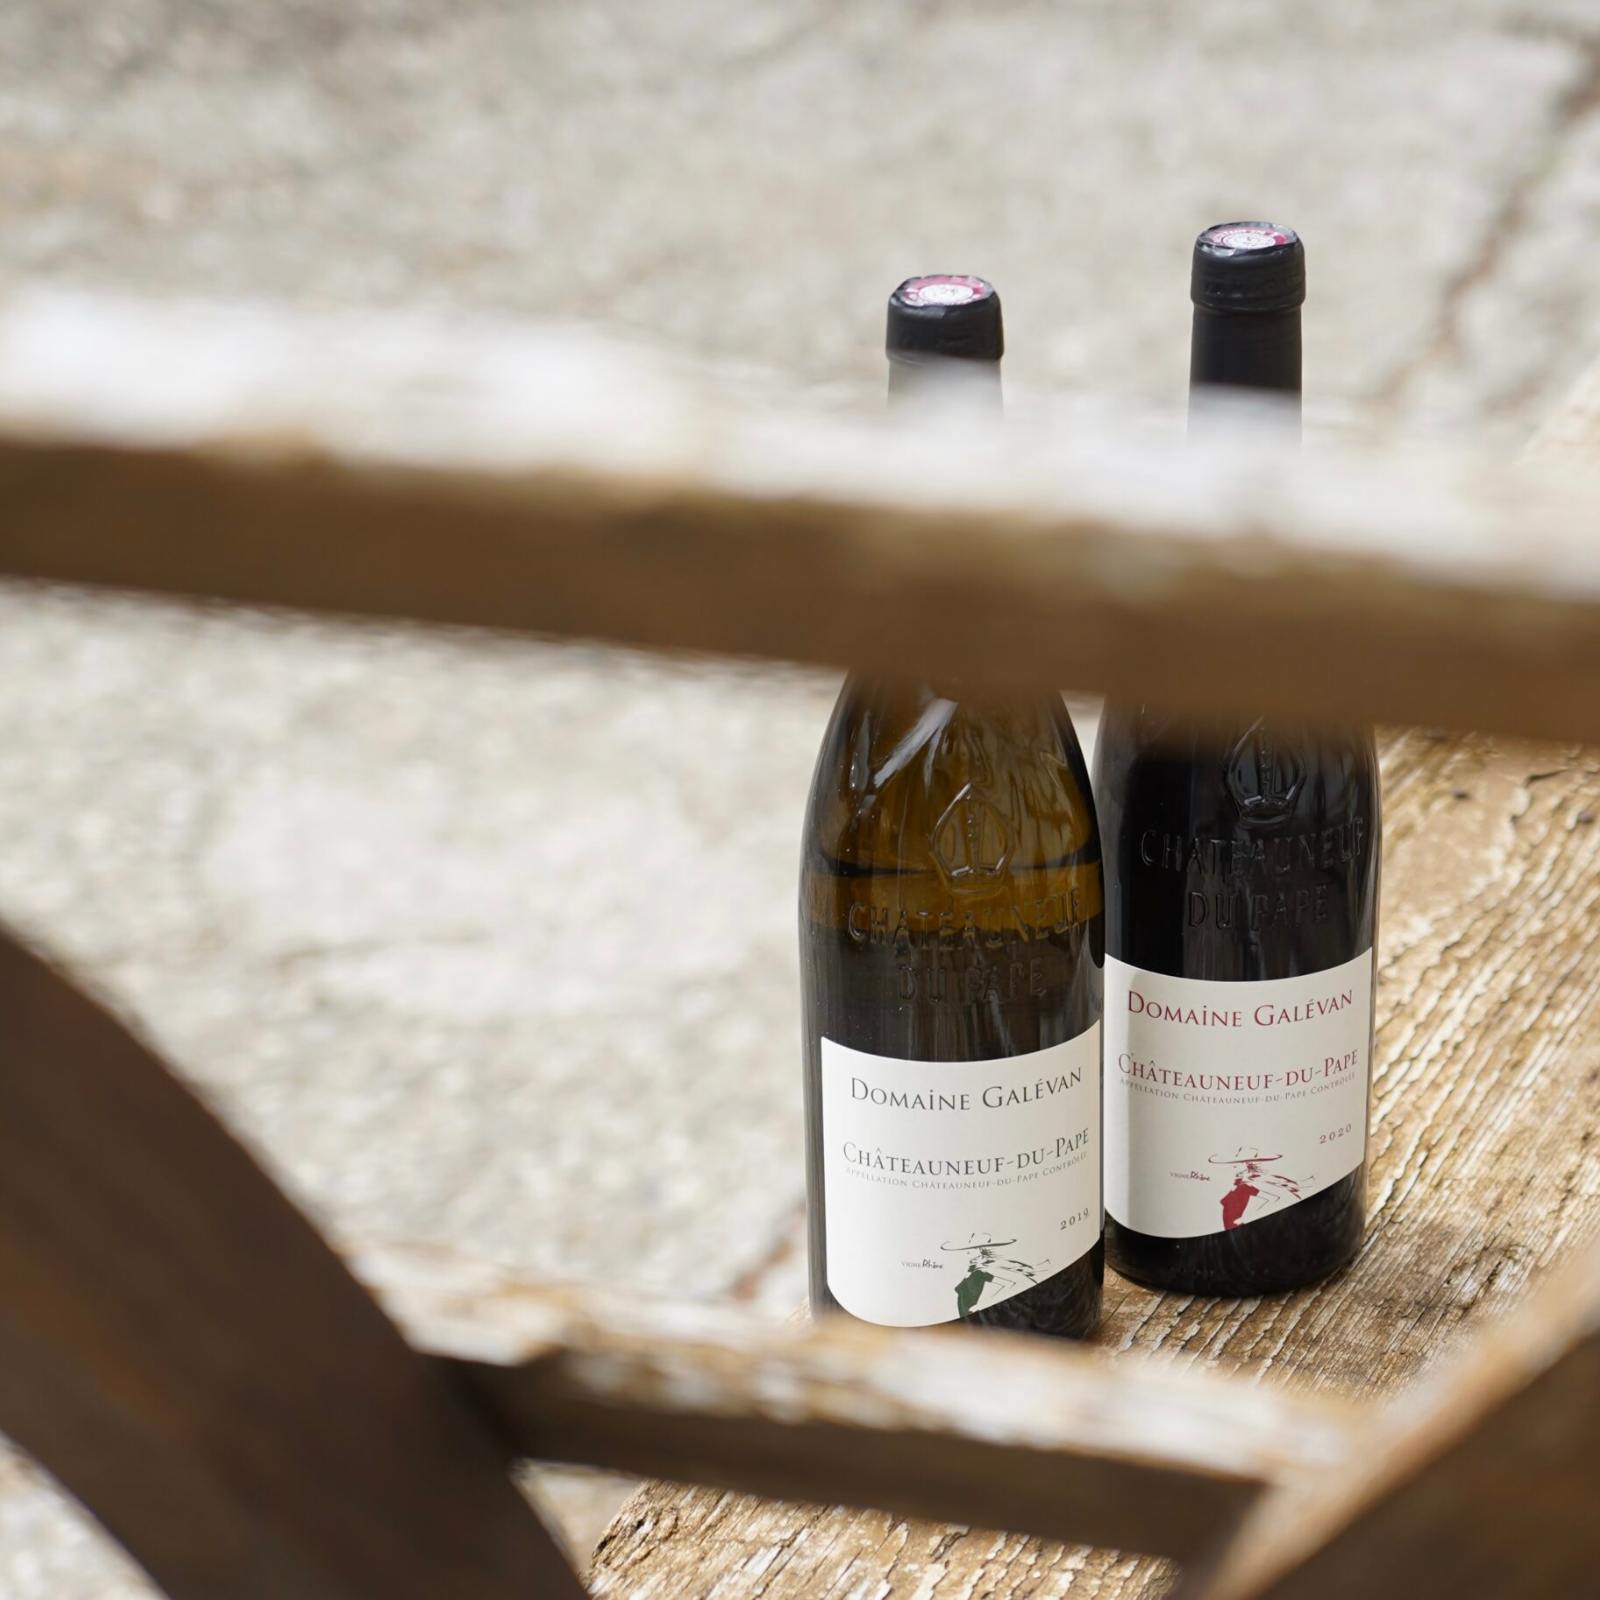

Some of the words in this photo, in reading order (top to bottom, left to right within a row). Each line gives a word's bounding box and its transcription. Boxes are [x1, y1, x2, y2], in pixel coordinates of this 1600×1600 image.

[1188, 891, 1232, 929] DU
[1251, 884, 1327, 929] PAPE
[1254, 989, 1353, 1027] GALÉVAN
[982, 1067, 1082, 1109] GALÉVAN
[1118, 1049, 1358, 1091] CHÂTEAUNEUF-DU-PAPE
[842, 1127, 1089, 1176] CHÂTEAUNEUF-DU-PAPE
[1319, 1124, 1352, 1145] 2020
[1059, 1207, 1090, 1231] 2019
